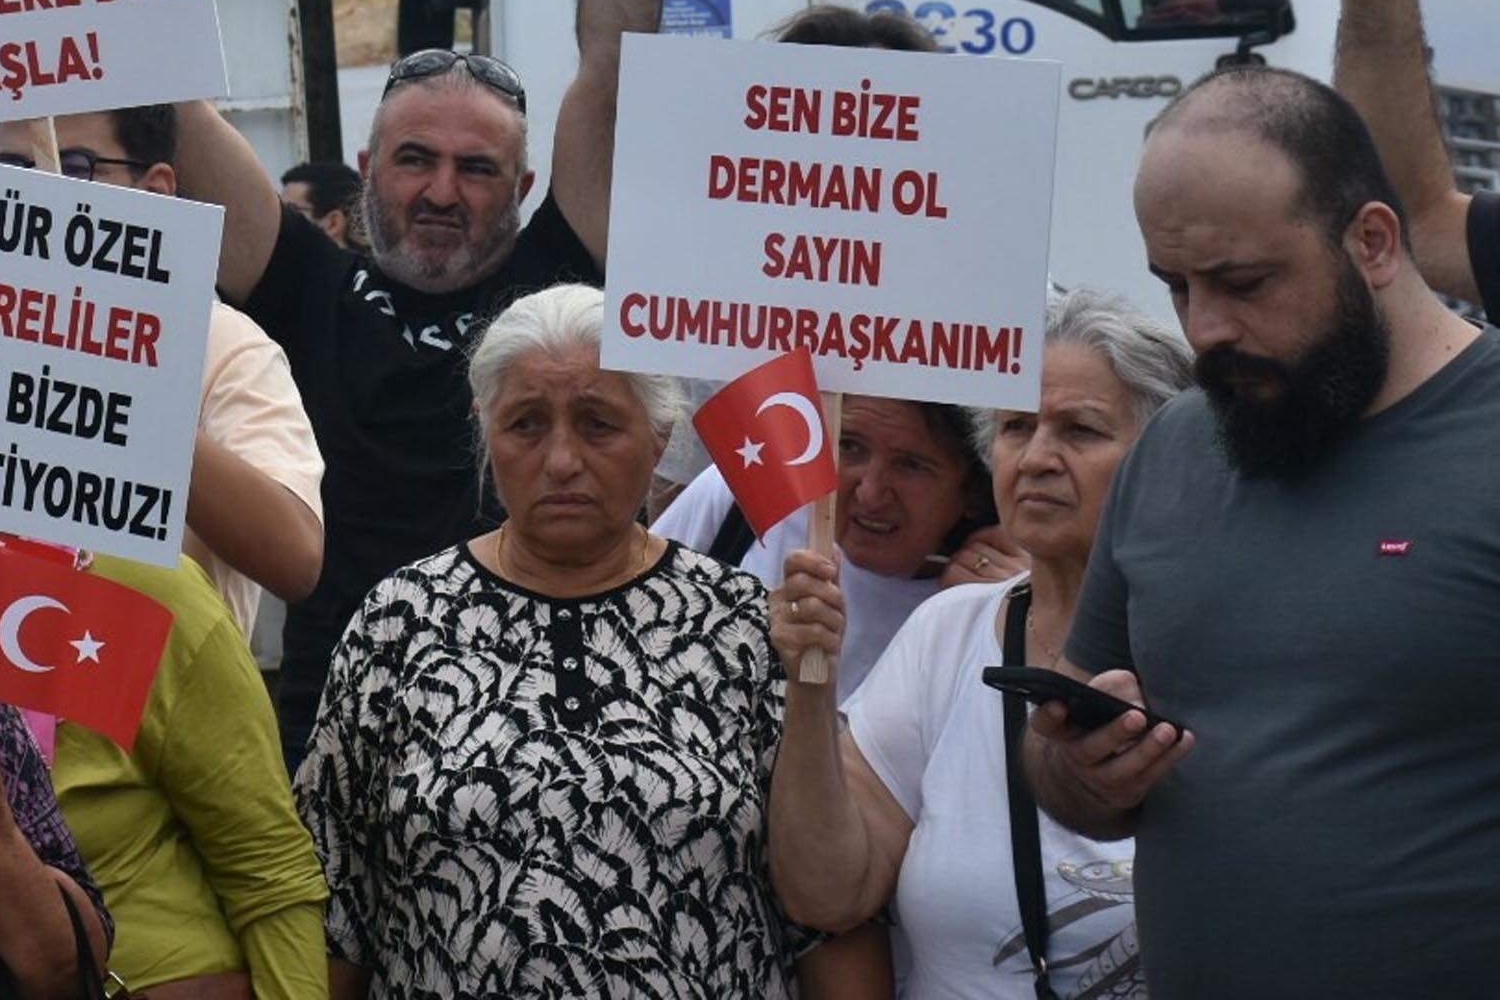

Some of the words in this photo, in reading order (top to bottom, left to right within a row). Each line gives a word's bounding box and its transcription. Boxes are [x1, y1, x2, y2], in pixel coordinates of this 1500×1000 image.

[746, 85, 823, 134] SEN
[832, 80, 921, 142] BİZE
[708, 155, 883, 212] DERMAN
[893, 170, 948, 219] OL
[65, 203, 169, 283] ÖZEL
[763, 233, 883, 286] SAYIN
[619, 292, 1022, 375] CUMHURBAŞKANIM!
[6, 365, 132, 446] BİZDE
